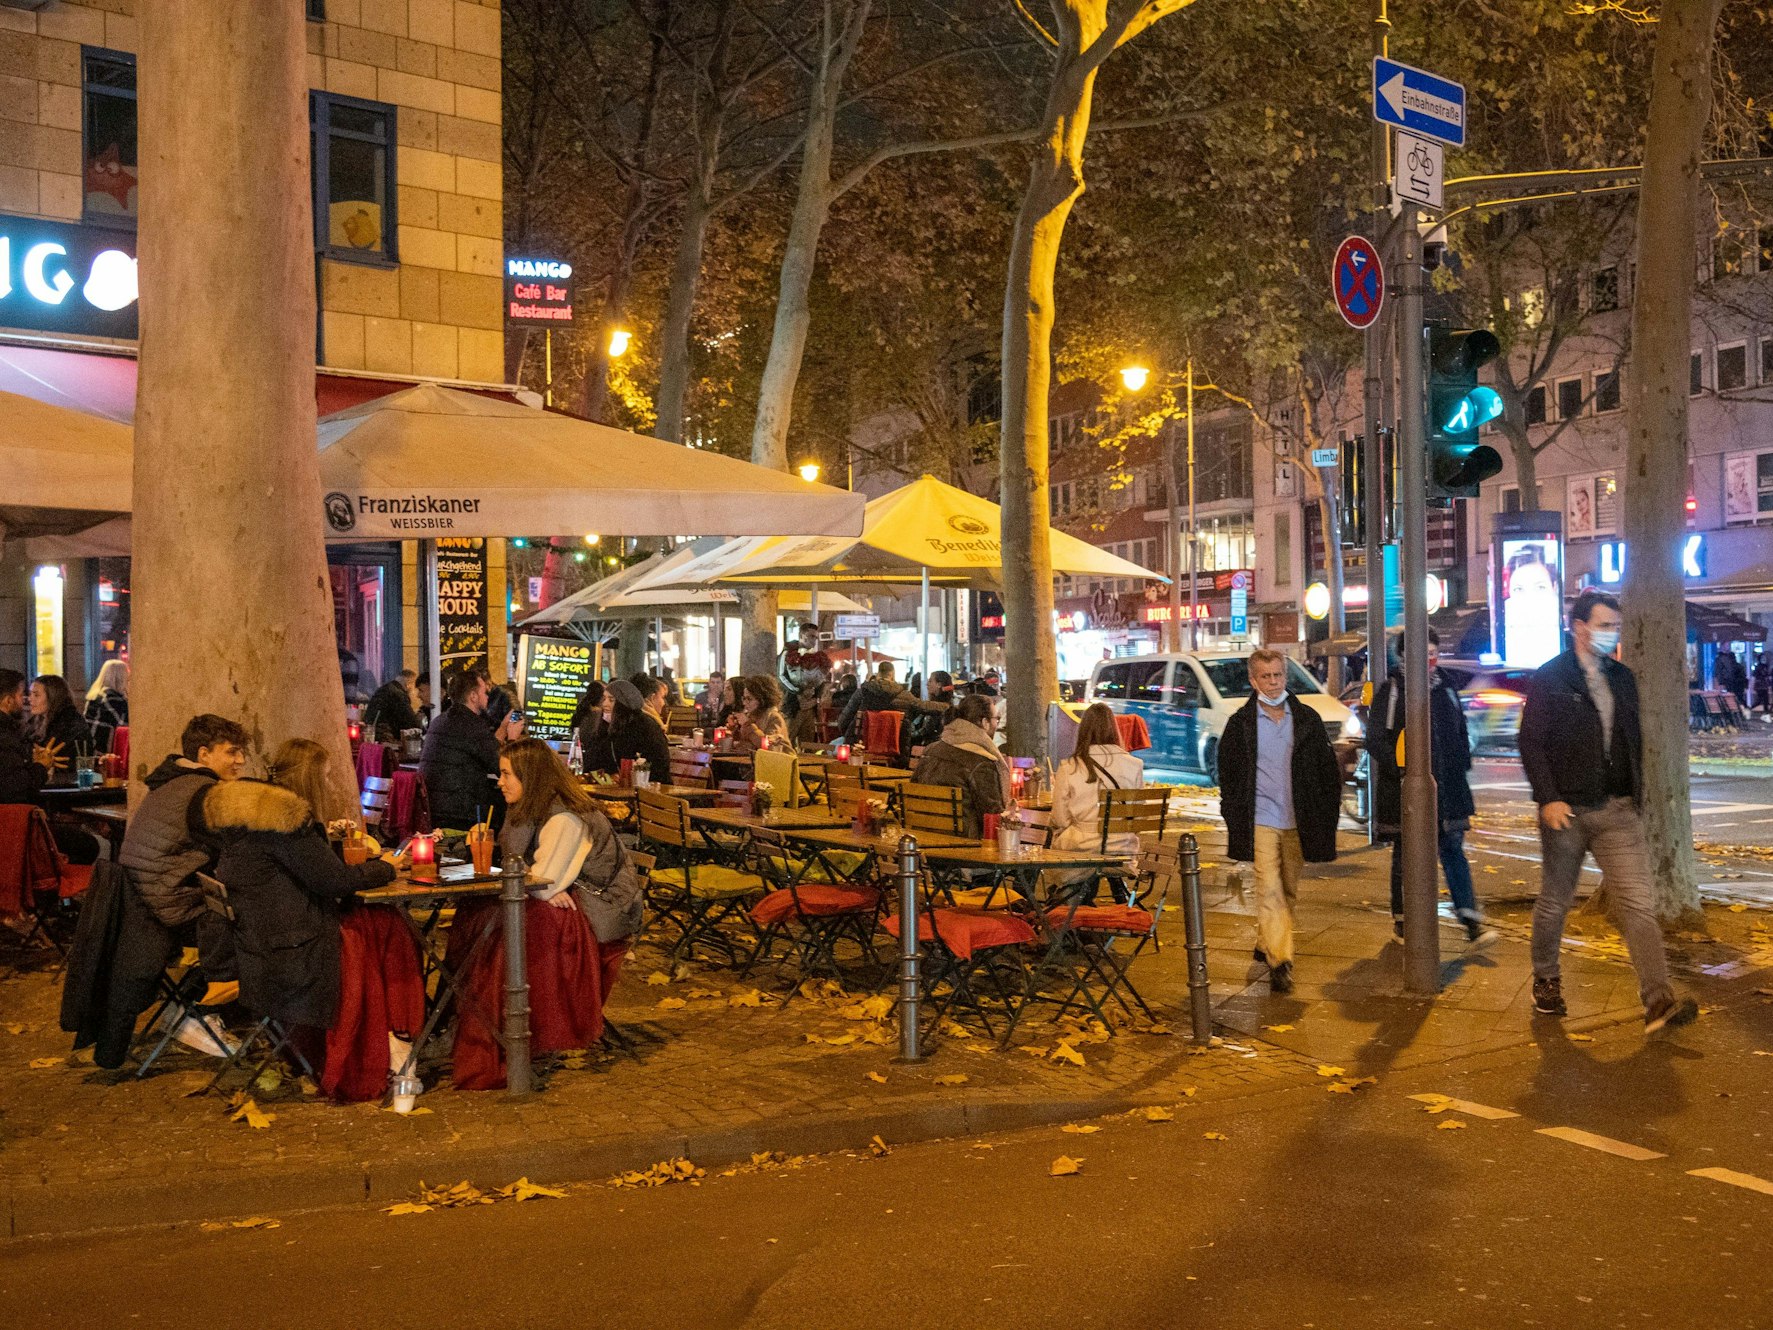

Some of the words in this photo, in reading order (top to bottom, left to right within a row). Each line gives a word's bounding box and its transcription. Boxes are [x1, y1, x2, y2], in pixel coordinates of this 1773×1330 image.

[1401, 90, 1459, 121] Einbahnstraße
[508, 260, 572, 279] MANGO
[514, 283, 542, 299] Café
[546, 285, 567, 301] Bar
[510, 302, 573, 320] Restaurant
[358, 495, 480, 514] Franziskaner
[390, 518, 454, 529] WEISSBIER
[925, 538, 1002, 554] Benedik
[438, 580, 484, 598] APPY
[448, 621, 484, 635] Cocktails
[535, 643, 591, 659] MANGO
[531, 660, 547, 670] AB
[549, 661, 592, 675] SOFORT
